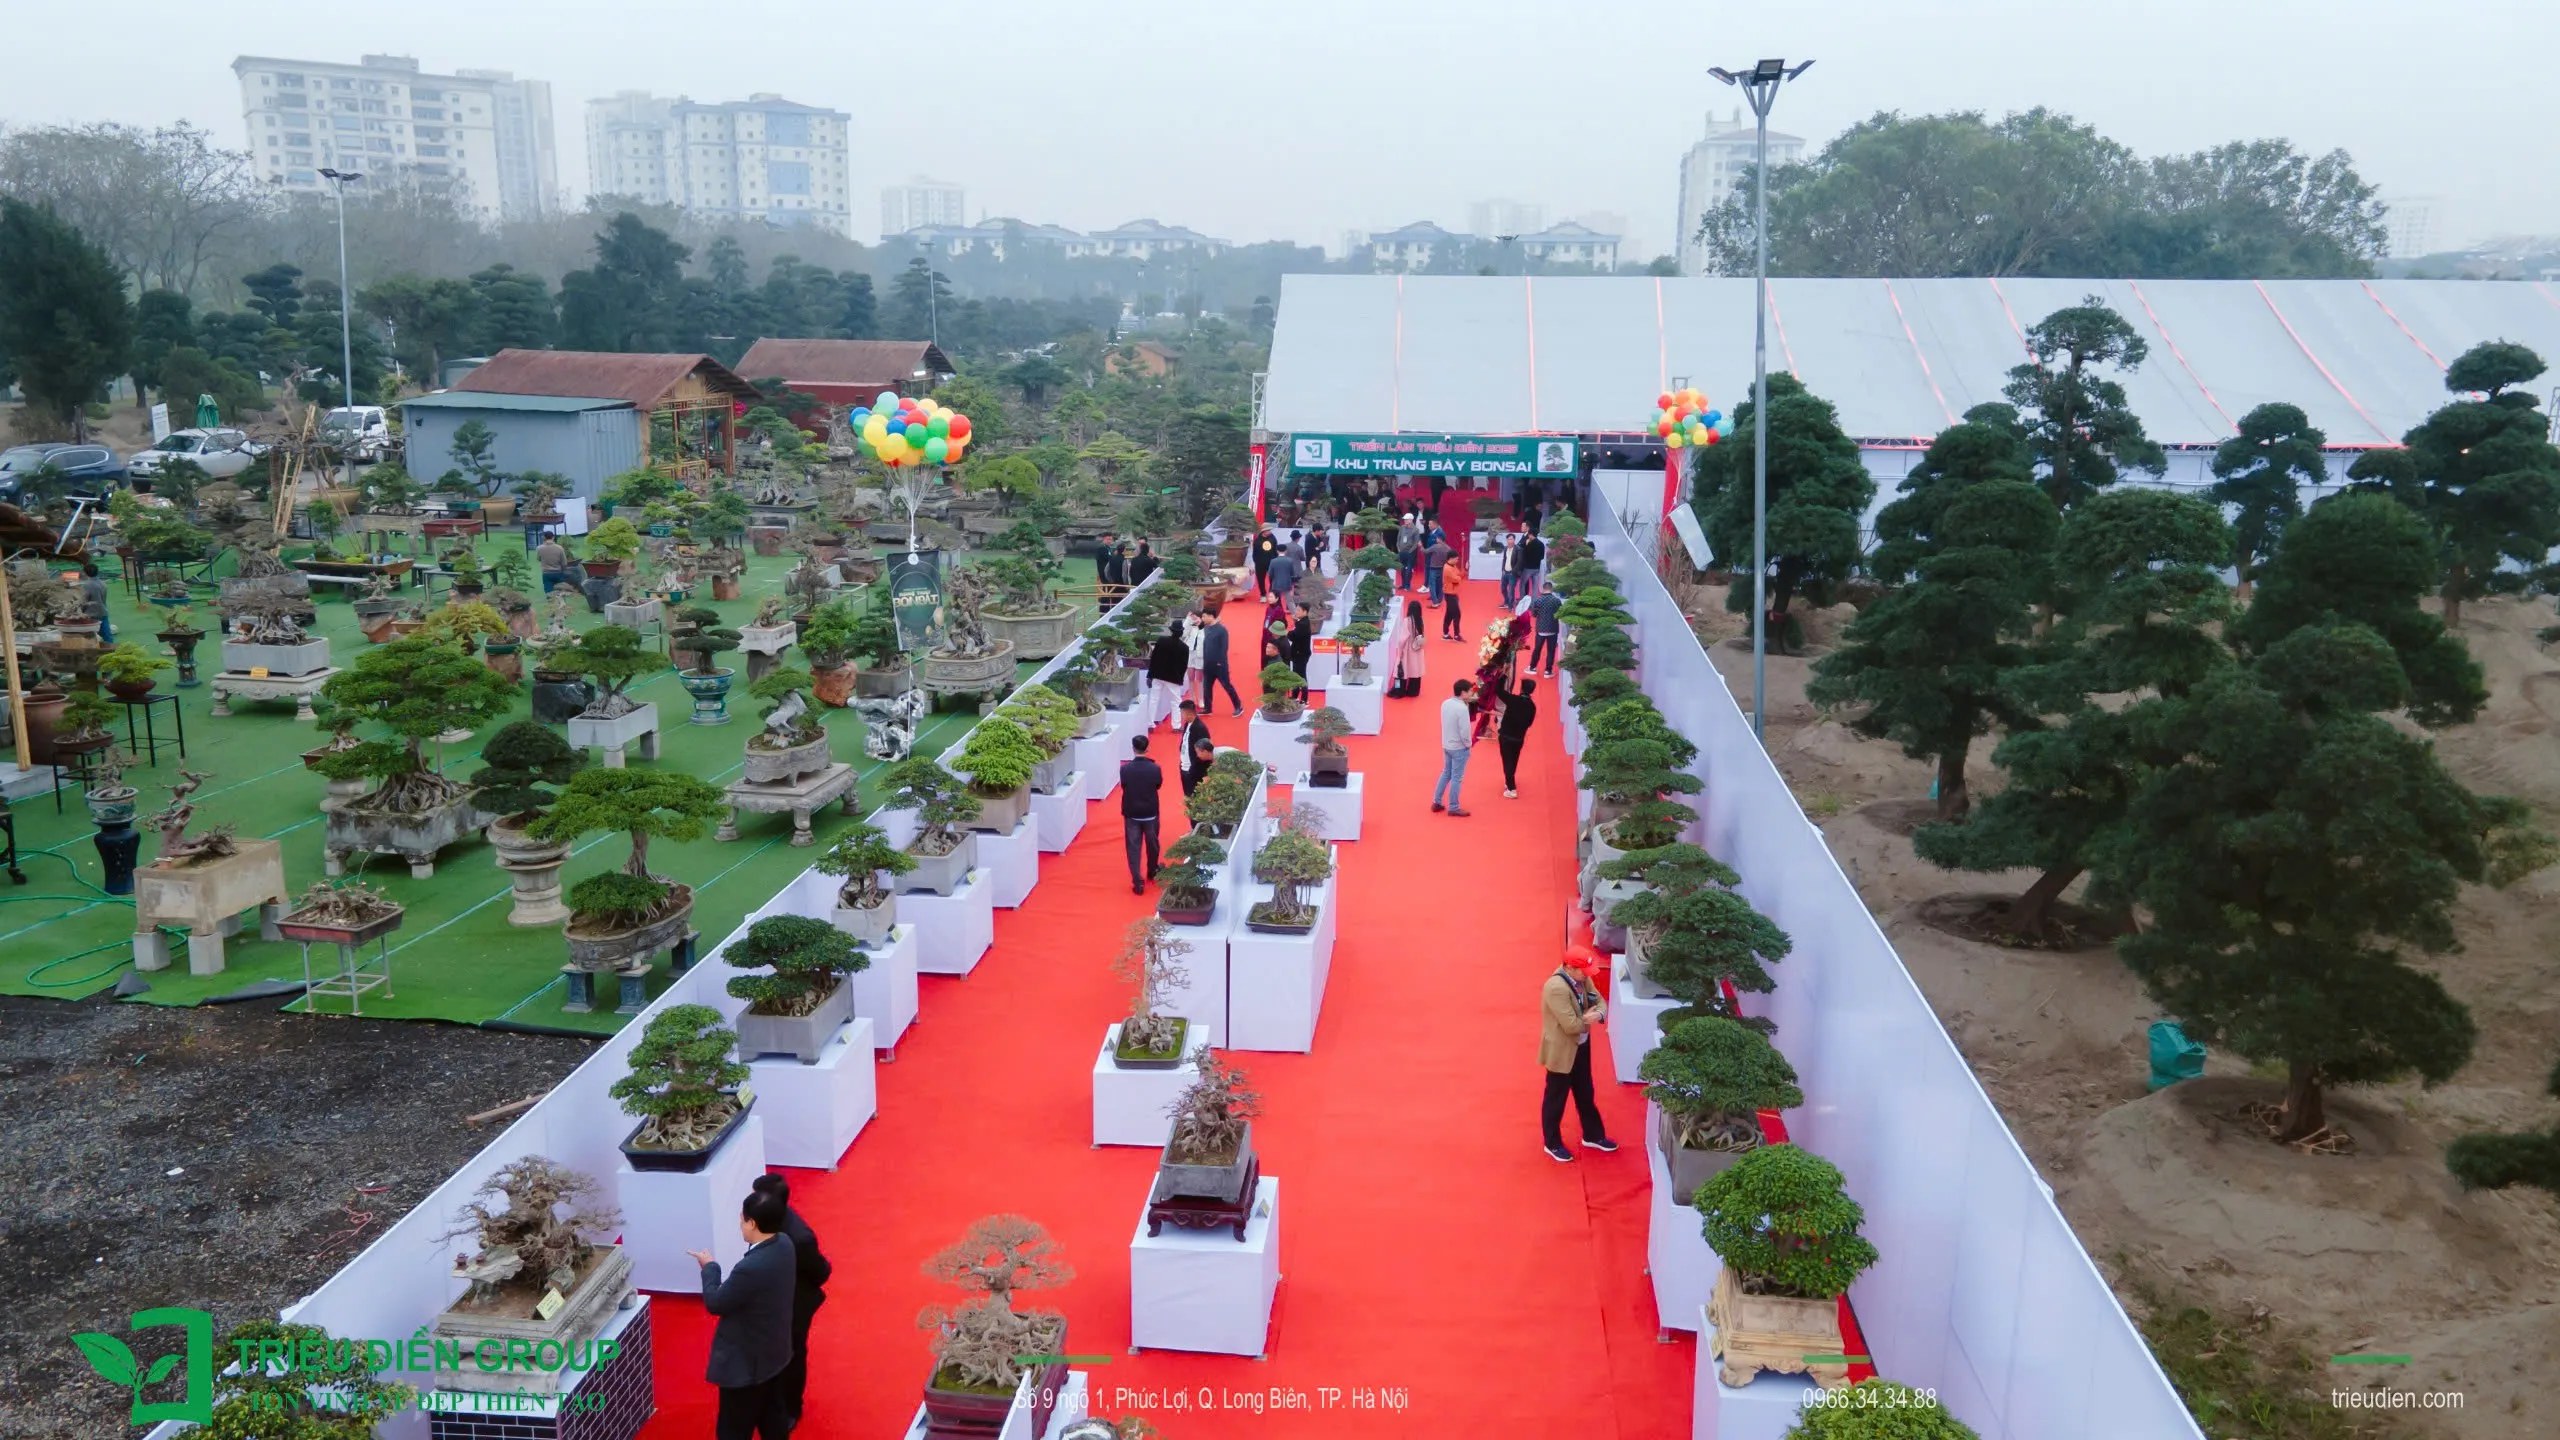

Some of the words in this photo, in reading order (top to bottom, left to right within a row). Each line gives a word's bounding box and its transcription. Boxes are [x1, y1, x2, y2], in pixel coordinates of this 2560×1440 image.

[1335, 459, 1368, 470] KHU
[1373, 457, 1427, 471] TRƯNG
[1431, 457, 1466, 471] BÀY
[1470, 461, 1532, 473] BONSAI
